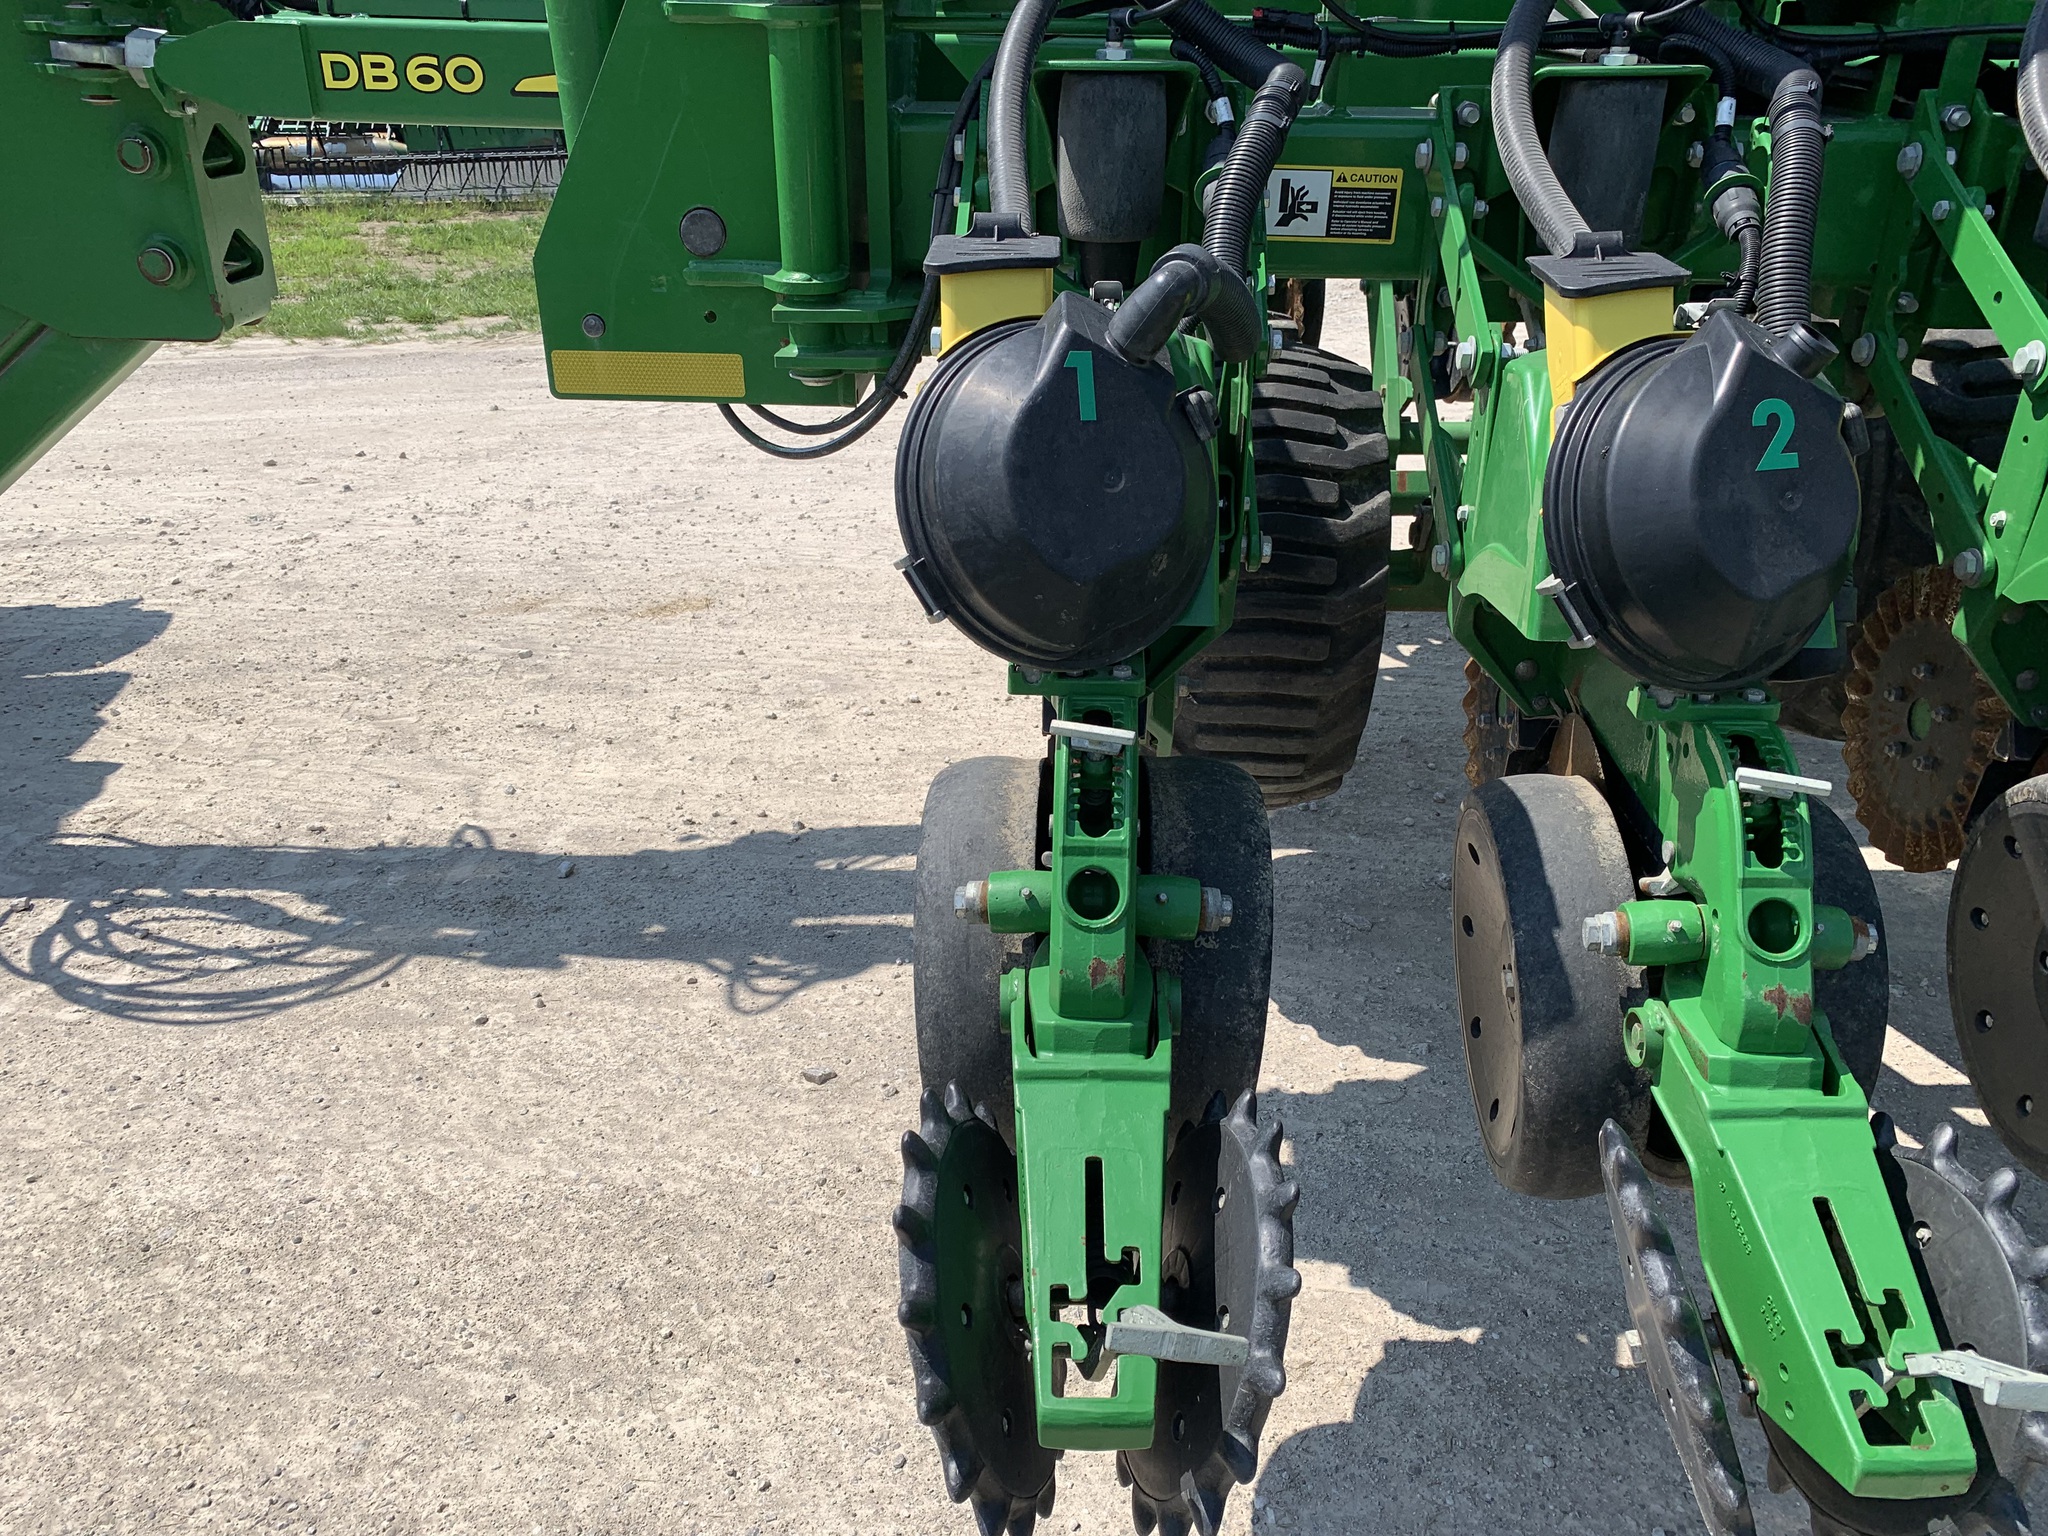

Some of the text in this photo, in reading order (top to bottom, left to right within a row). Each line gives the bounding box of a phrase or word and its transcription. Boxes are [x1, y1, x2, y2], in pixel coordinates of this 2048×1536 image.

[1350, 173, 1398, 183] CAUTION
[1064, 350, 1097, 421] 1
[1752, 398, 1800, 472] 2
